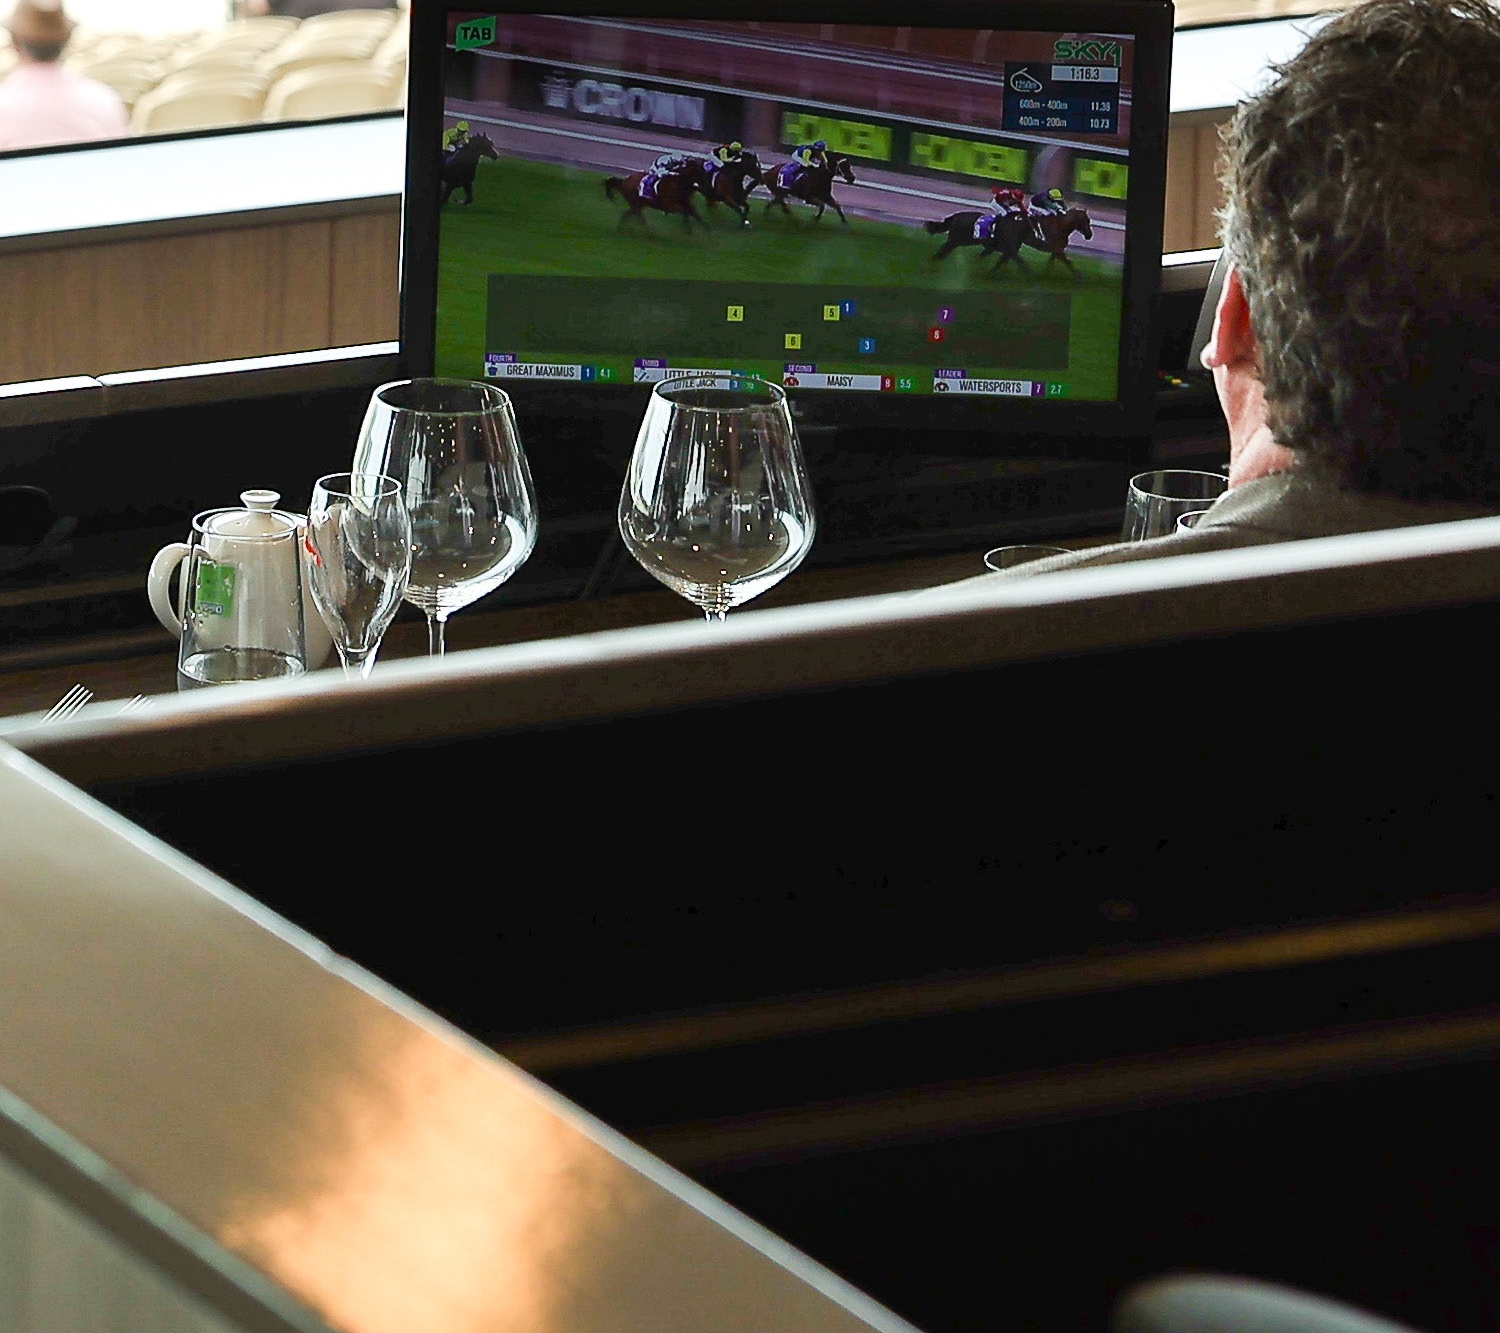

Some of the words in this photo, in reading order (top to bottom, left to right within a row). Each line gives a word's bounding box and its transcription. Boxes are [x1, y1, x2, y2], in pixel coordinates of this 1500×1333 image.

[460, 25, 492, 41] TAB
[1070, 67, 1100, 81] 1:16.3
[1047, 100, 1068, 110] 400m
[1018, 116, 1040, 127] 400m
[1046, 117, 1067, 128] 200m
[506, 364, 533, 377] GREAT
[535, 365, 575, 378] MAXIMUS
[600, 368, 611, 378] 4.1
[826, 375, 854, 388] MAISY
[900, 379, 911, 389] 5.5
[958, 379, 1022, 394] WATERSPORTS
[1050, 385, 1061, 395] 2.7
